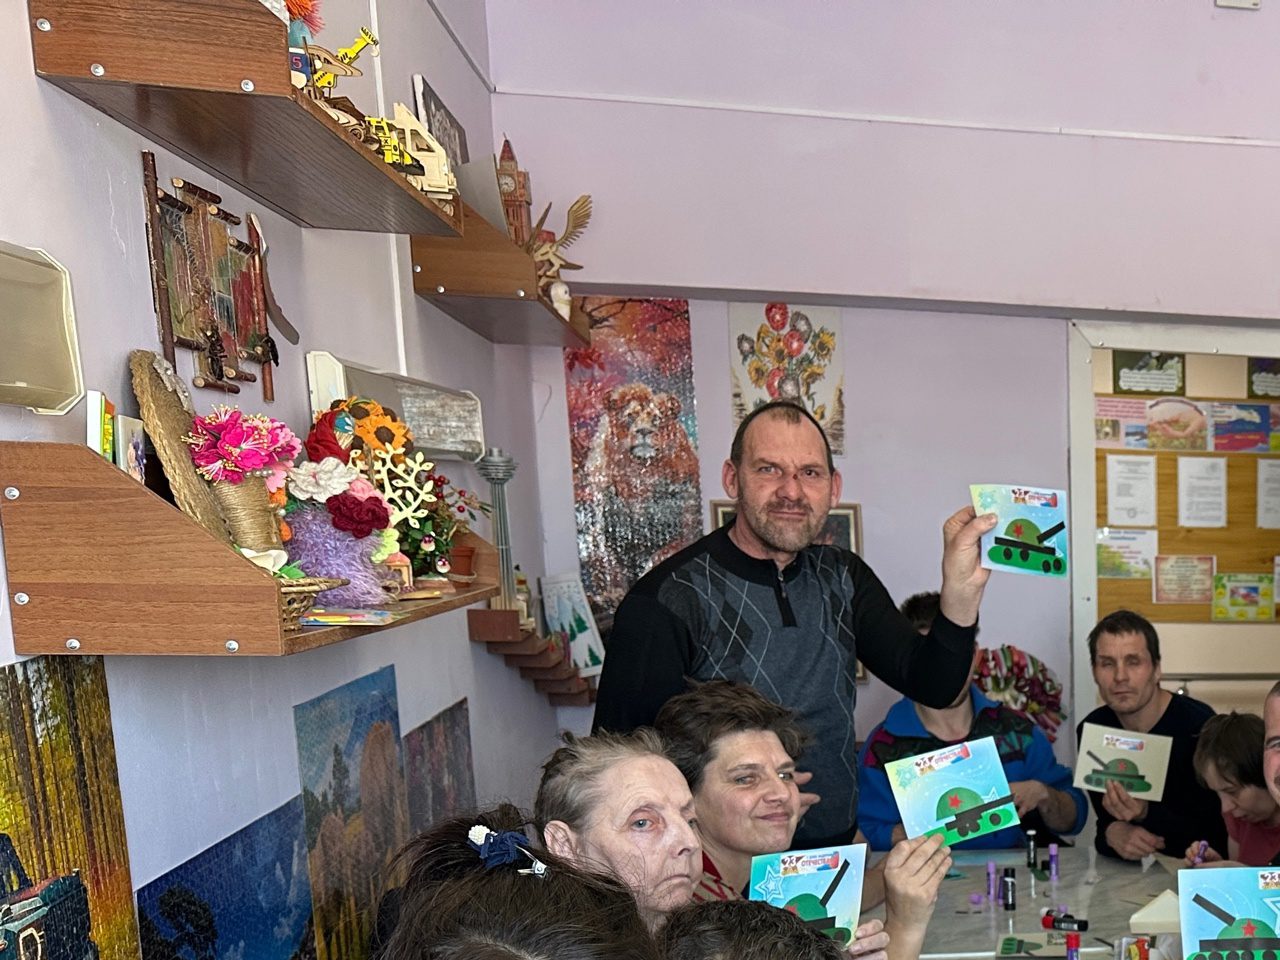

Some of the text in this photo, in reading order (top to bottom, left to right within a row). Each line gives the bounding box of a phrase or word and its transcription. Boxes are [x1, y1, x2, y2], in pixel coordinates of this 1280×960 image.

[292, 56, 303, 69] 5
[784, 856, 797, 867] 23
[1264, 873, 1279, 883] 23
